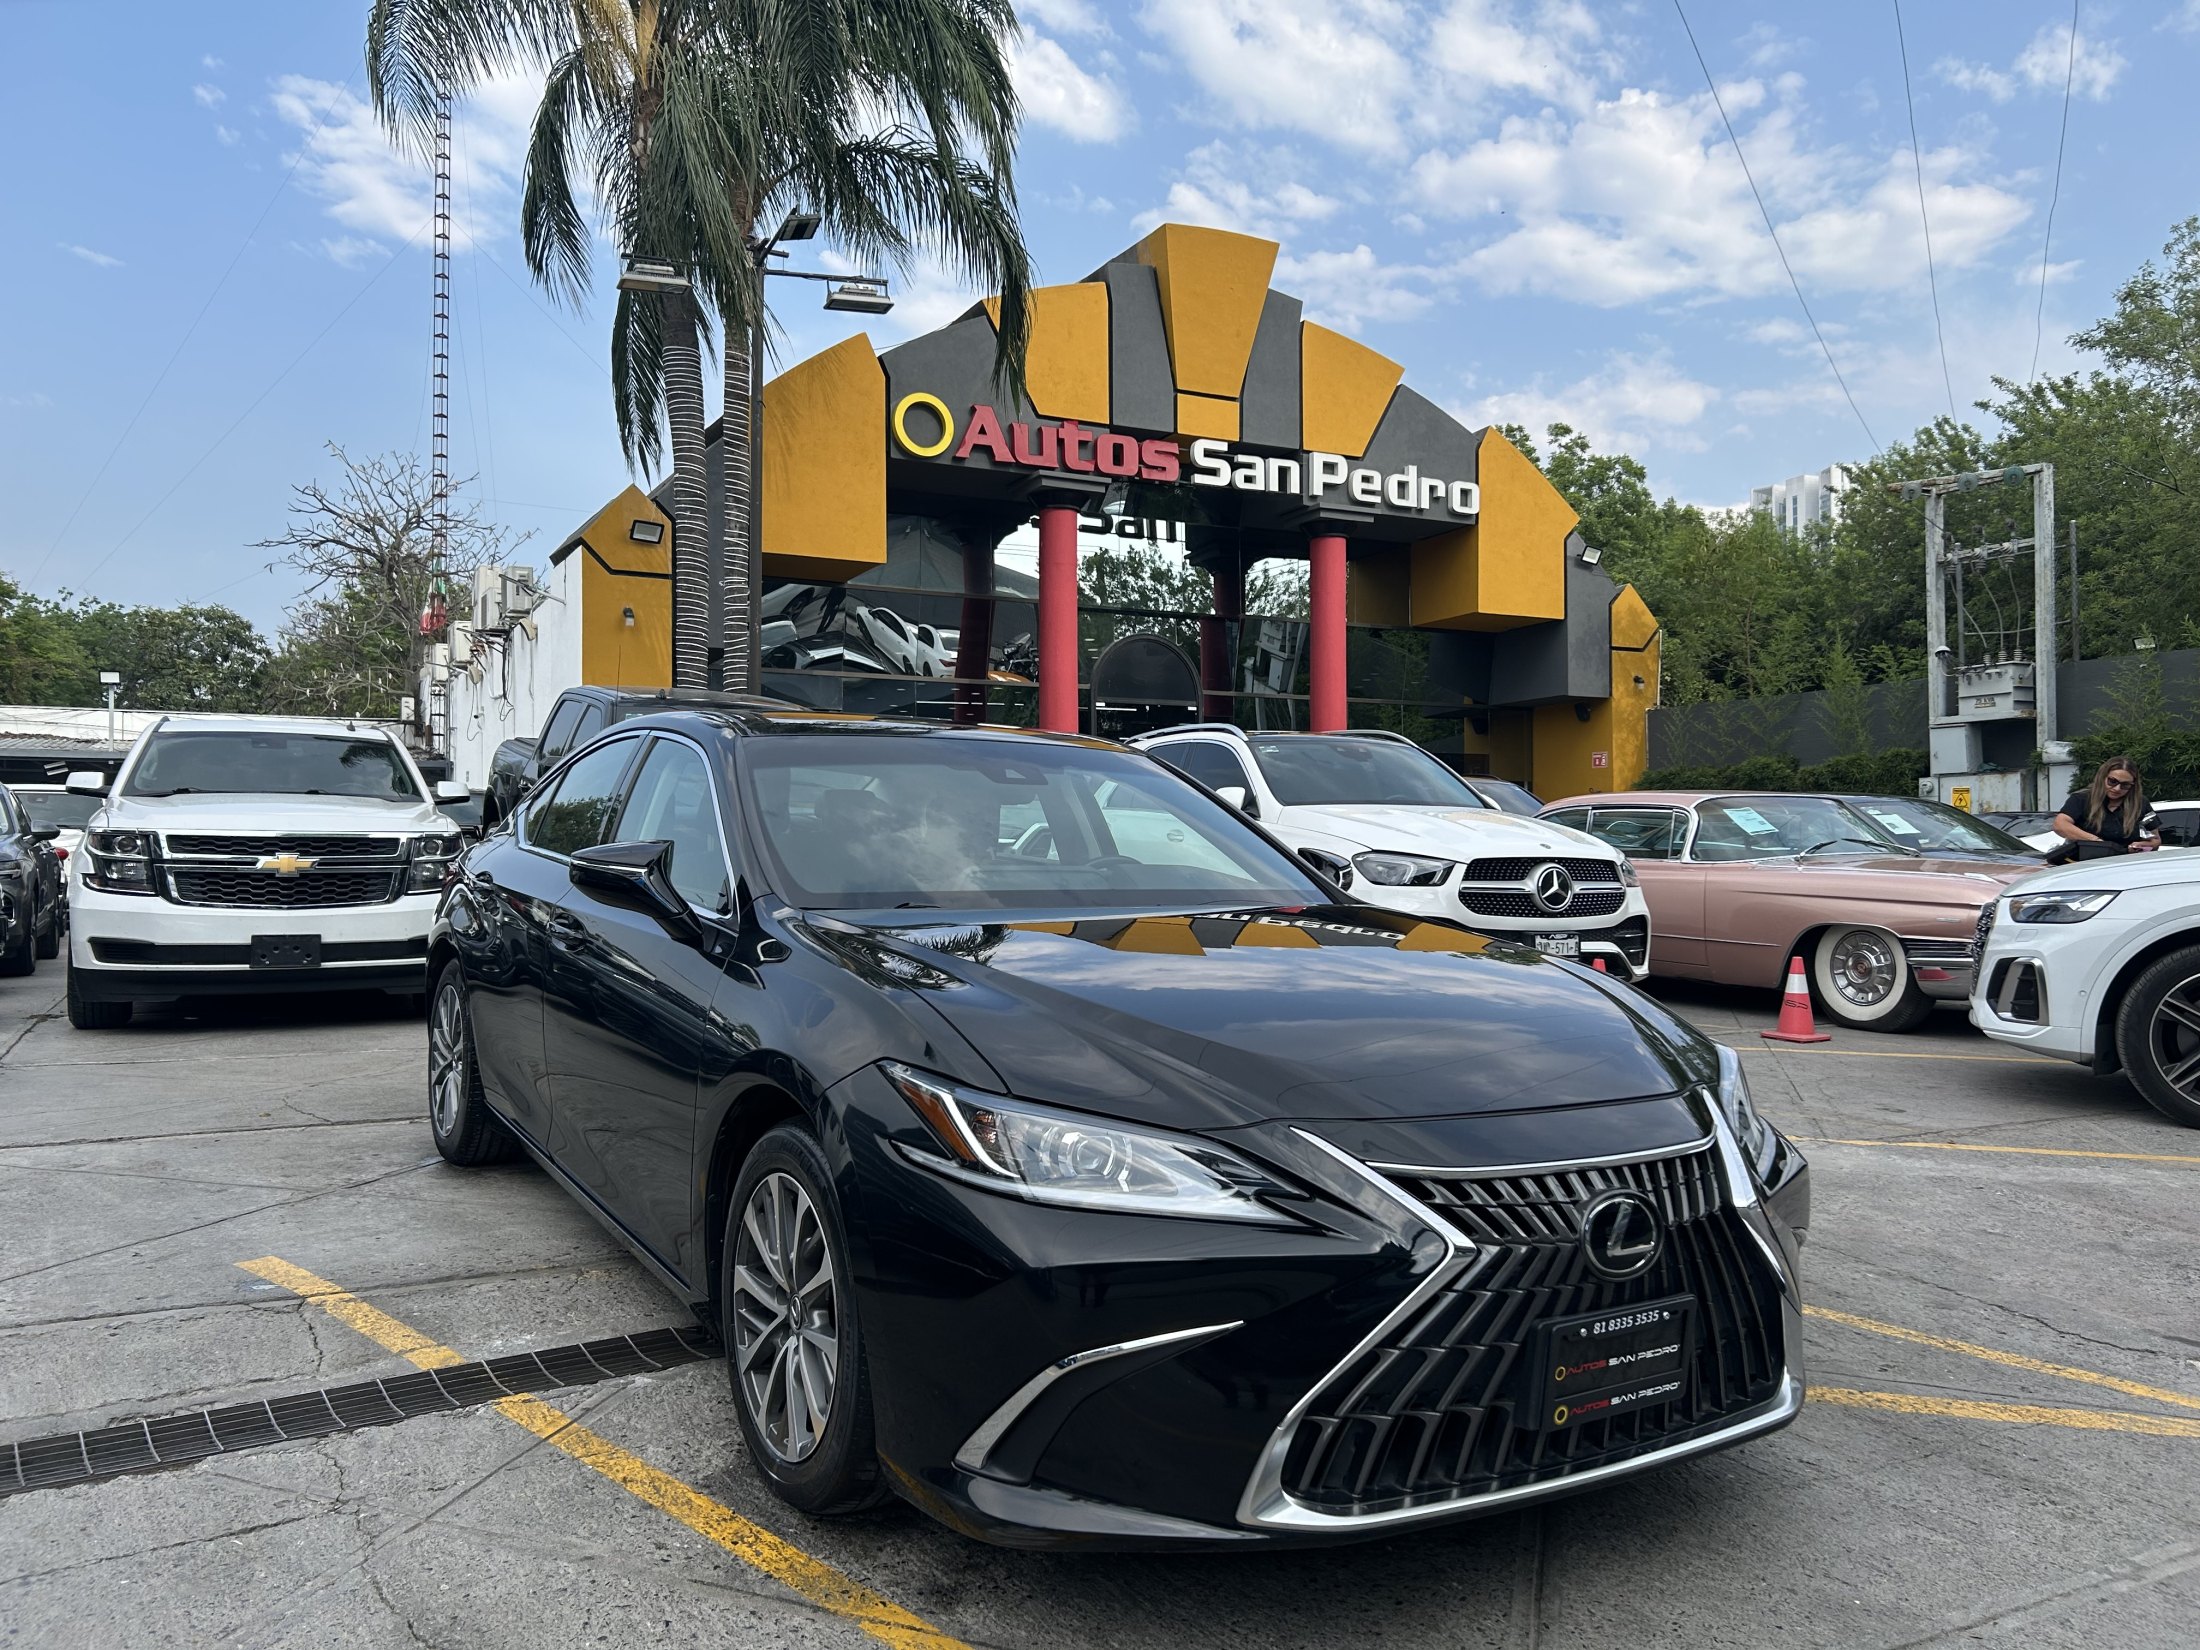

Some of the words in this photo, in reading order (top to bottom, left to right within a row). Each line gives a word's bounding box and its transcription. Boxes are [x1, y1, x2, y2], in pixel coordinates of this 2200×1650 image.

[954, 404, 1181, 482] Autos
[1190, 438, 1301, 495] San
[1308, 452, 1480, 515] Pedro
[1593, 1322, 1606, 1334] 81
[1608, 1316, 1633, 1331] 8335
[1634, 1310, 1659, 1325] 3535
[1566, 1359, 1607, 1376] AUTOS
[1608, 1354, 1636, 1366] SAN
[1637, 1344, 1678, 1360] PEDRO
[1570, 1400, 1609, 1416] AUTOS
[1611, 1392, 1636, 1405] SAN
[1638, 1382, 1677, 1399] PEDRO
